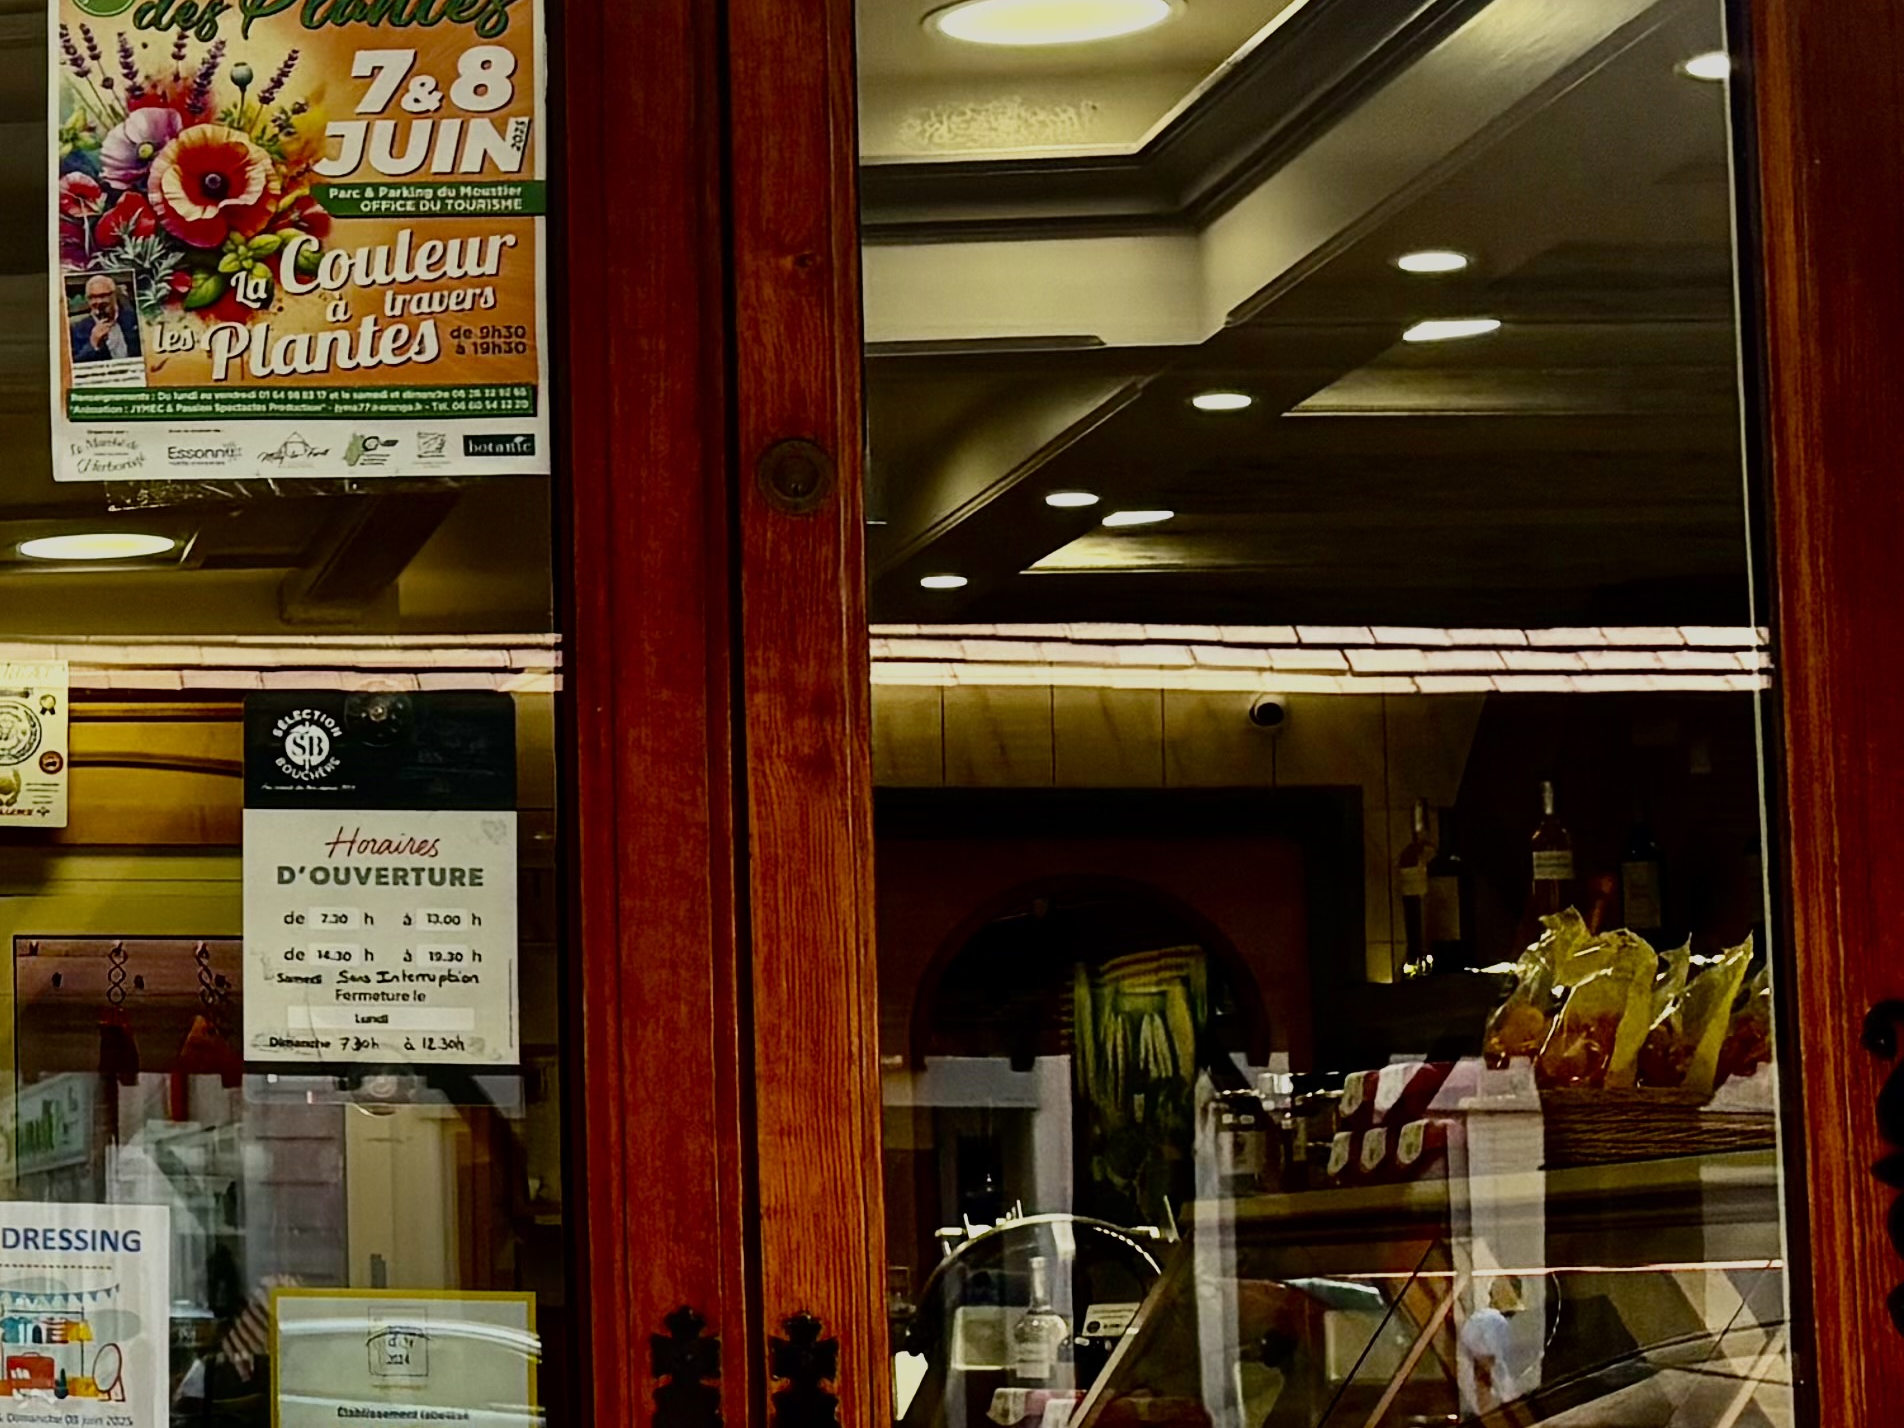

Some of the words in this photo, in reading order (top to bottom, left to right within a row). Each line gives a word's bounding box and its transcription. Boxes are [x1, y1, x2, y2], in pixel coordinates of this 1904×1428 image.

[312, 117, 531, 178] JUIN
[328, 186, 360, 199] Parc
[364, 186, 375, 198] &
[378, 186, 433, 200] Parking
[437, 186, 456, 197] du
[460, 185, 522, 197] Moustier
[360, 200, 416, 212] OFFICE
[419, 200, 441, 212] DU
[445, 198, 523, 211] TOURISME
[229, 271, 269, 309] La
[279, 228, 517, 296] Couleur
[326, 292, 350, 322] à
[384, 286, 497, 318] travers
[448, 324, 473, 340] de
[479, 324, 527, 340] 9h30
[153, 322, 196, 354] les
[204, 306, 441, 380] Plantes
[453, 341, 466, 355] à
[472, 341, 528, 355] 19h30
[468, 436, 532, 454] botanic
[324, 826, 440, 859] Horaires
[276, 865, 485, 889] D'OUVERTURE
[283, 910, 305, 925] de
[364, 912, 374, 926] h
[402, 912, 412, 926] à
[471, 912, 482, 927] h
[283, 947, 305, 962] de
[364, 948, 374, 962] h
[402, 948, 412, 963] à
[472, 948, 482, 963] h
[335, 988, 410, 1002] Fermeture
[413, 989, 427, 1002] le
[403, 1035, 415, 1051] à
[1, 1227, 143, 1253] DRESSING
